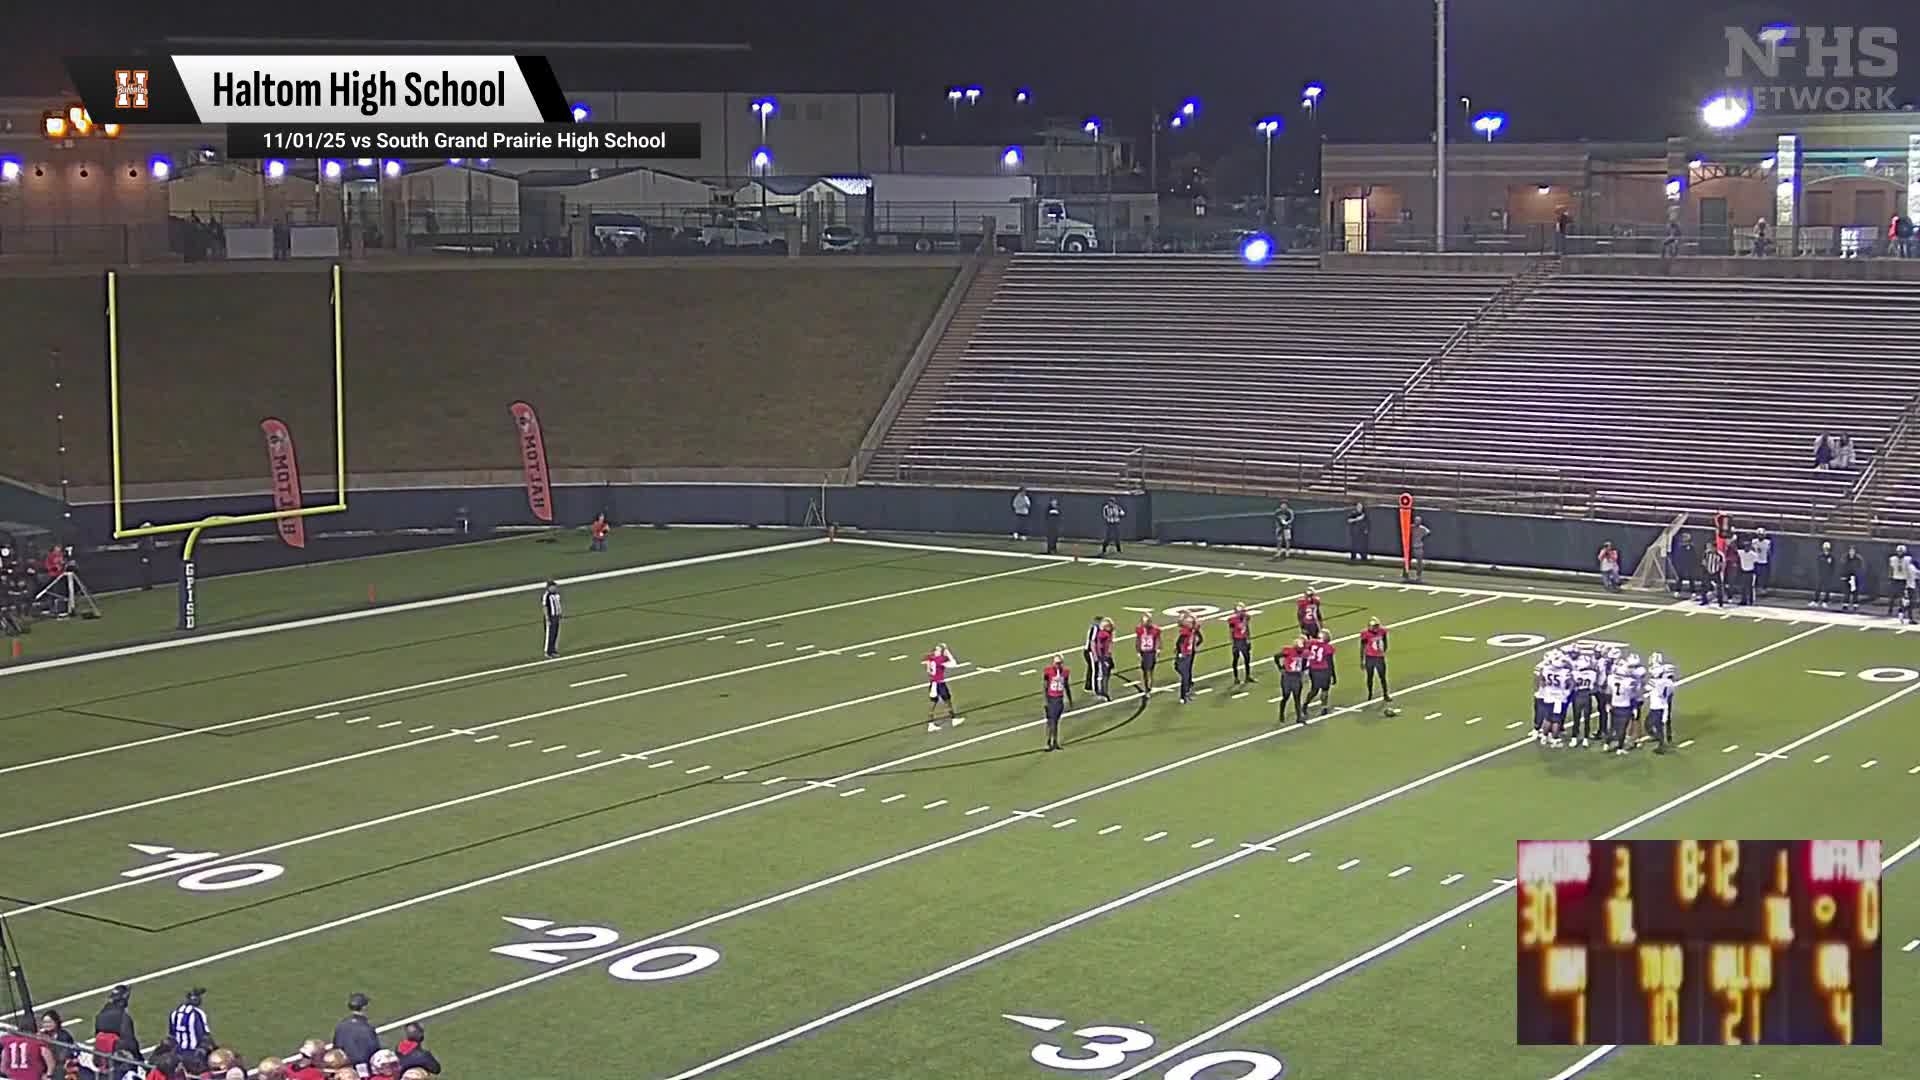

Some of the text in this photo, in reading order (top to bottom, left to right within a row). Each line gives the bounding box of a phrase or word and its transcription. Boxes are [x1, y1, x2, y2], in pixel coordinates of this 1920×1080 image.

[184, 563, 195, 629] GPISD
[1547, 673, 1561, 687] 55
[121, 852, 284, 891] 10
[491, 926, 720, 980] 20
[9, 1042, 29, 1068] 11
[1032, 1026, 1283, 1080] 30
